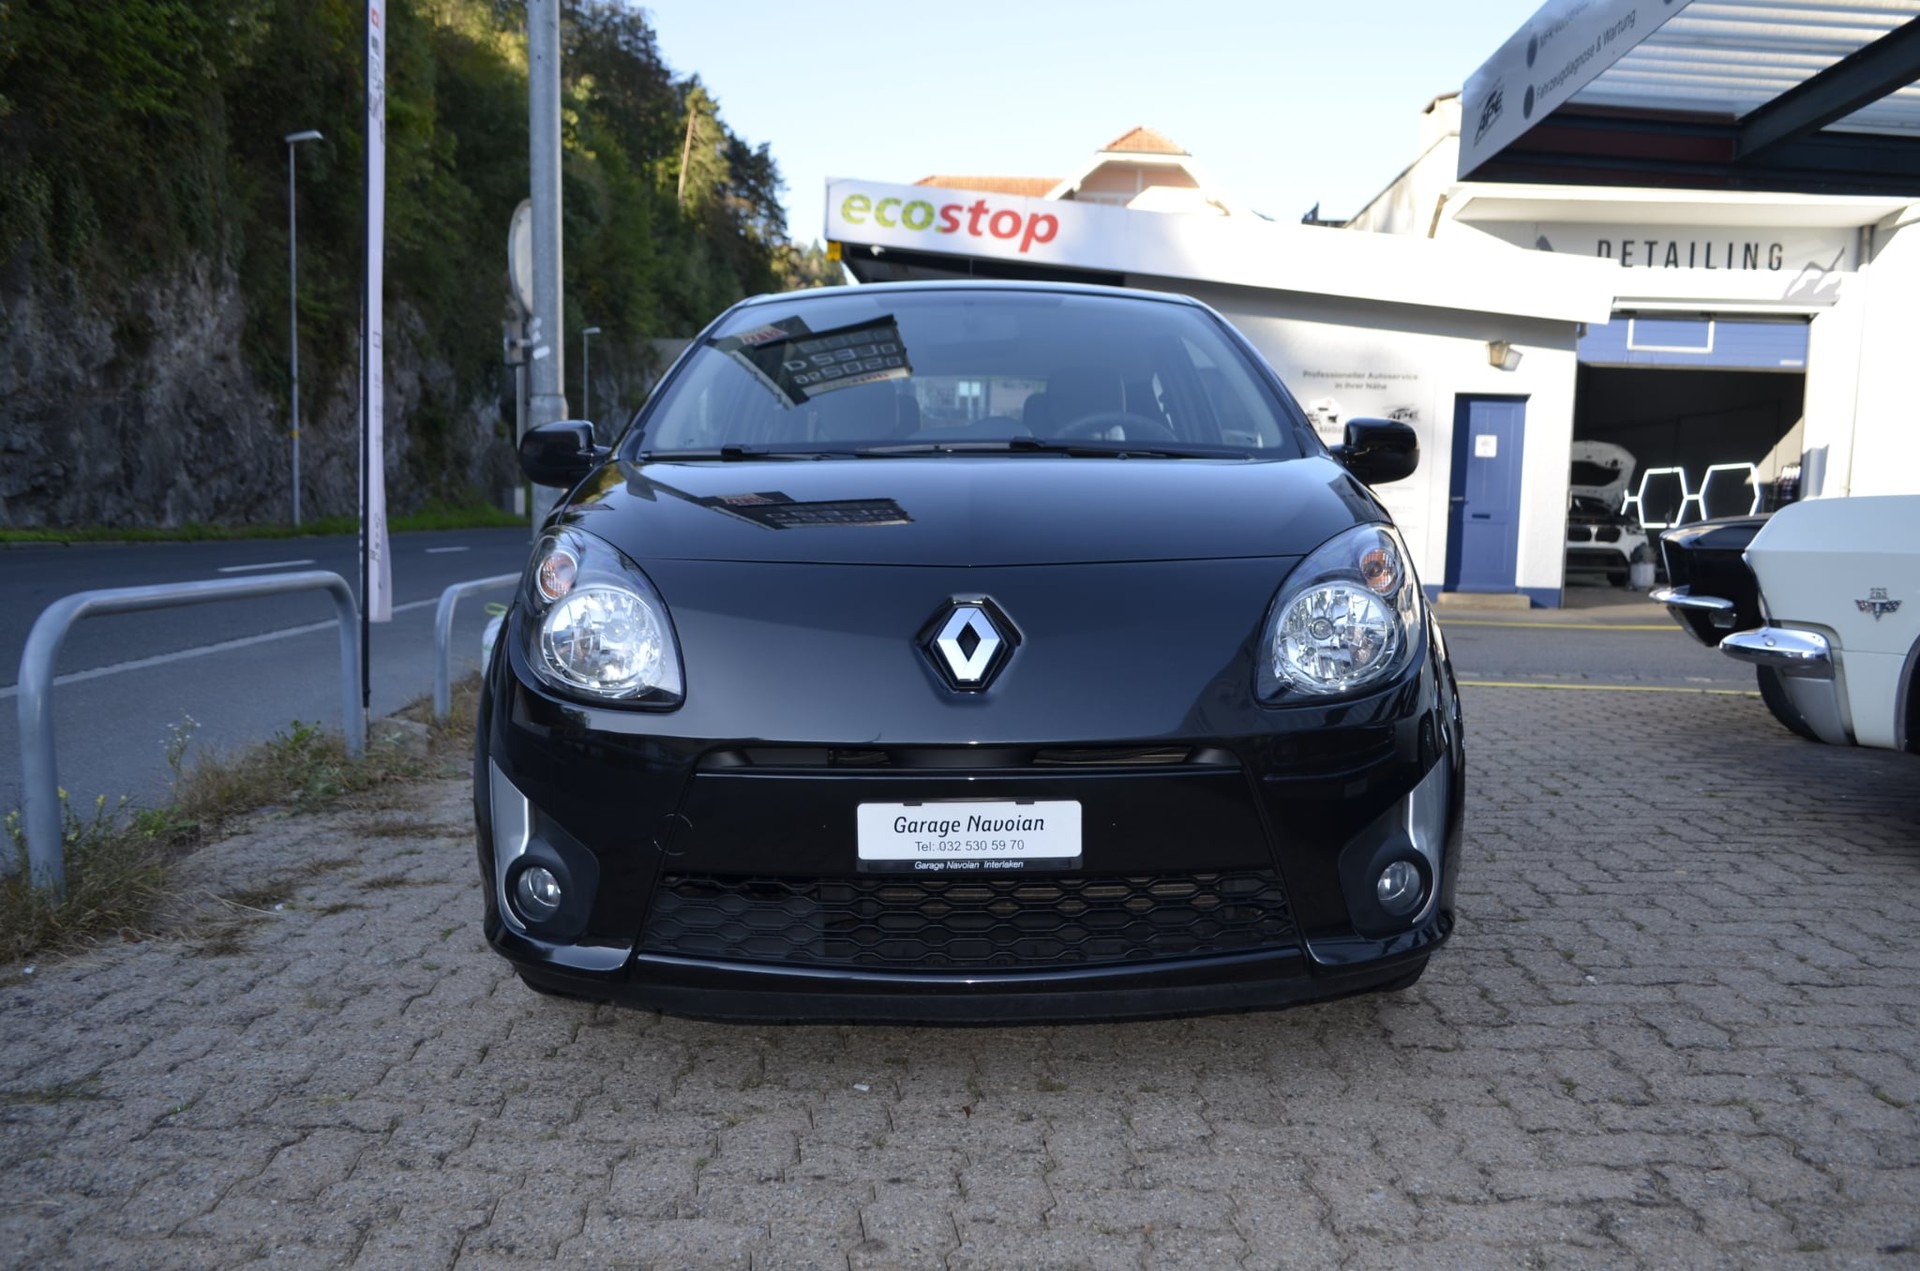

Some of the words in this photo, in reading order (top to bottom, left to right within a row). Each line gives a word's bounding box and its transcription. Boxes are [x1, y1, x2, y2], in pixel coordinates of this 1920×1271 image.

[1536, 44, 1595, 100] Fahrzeugdiagnose
[1596, 35, 1602, 53] &
[1603, 8, 1636, 46] Wartung
[840, 193, 1059, 253] ecostop
[1597, 239, 1784, 271] DETAILING
[893, 815, 961, 838] Garage
[967, 815, 1045, 833] Navoian
[915, 841, 935, 852] Tel:
[938, 841, 961, 852] 032
[965, 840, 987, 851] 530
[991, 840, 1006, 851] 59
[1010, 839, 1025, 850] 70
[914, 861, 945, 871] Garage
[946, 861, 980, 870] Navoian
[983, 860, 1024, 869] Interlaken
